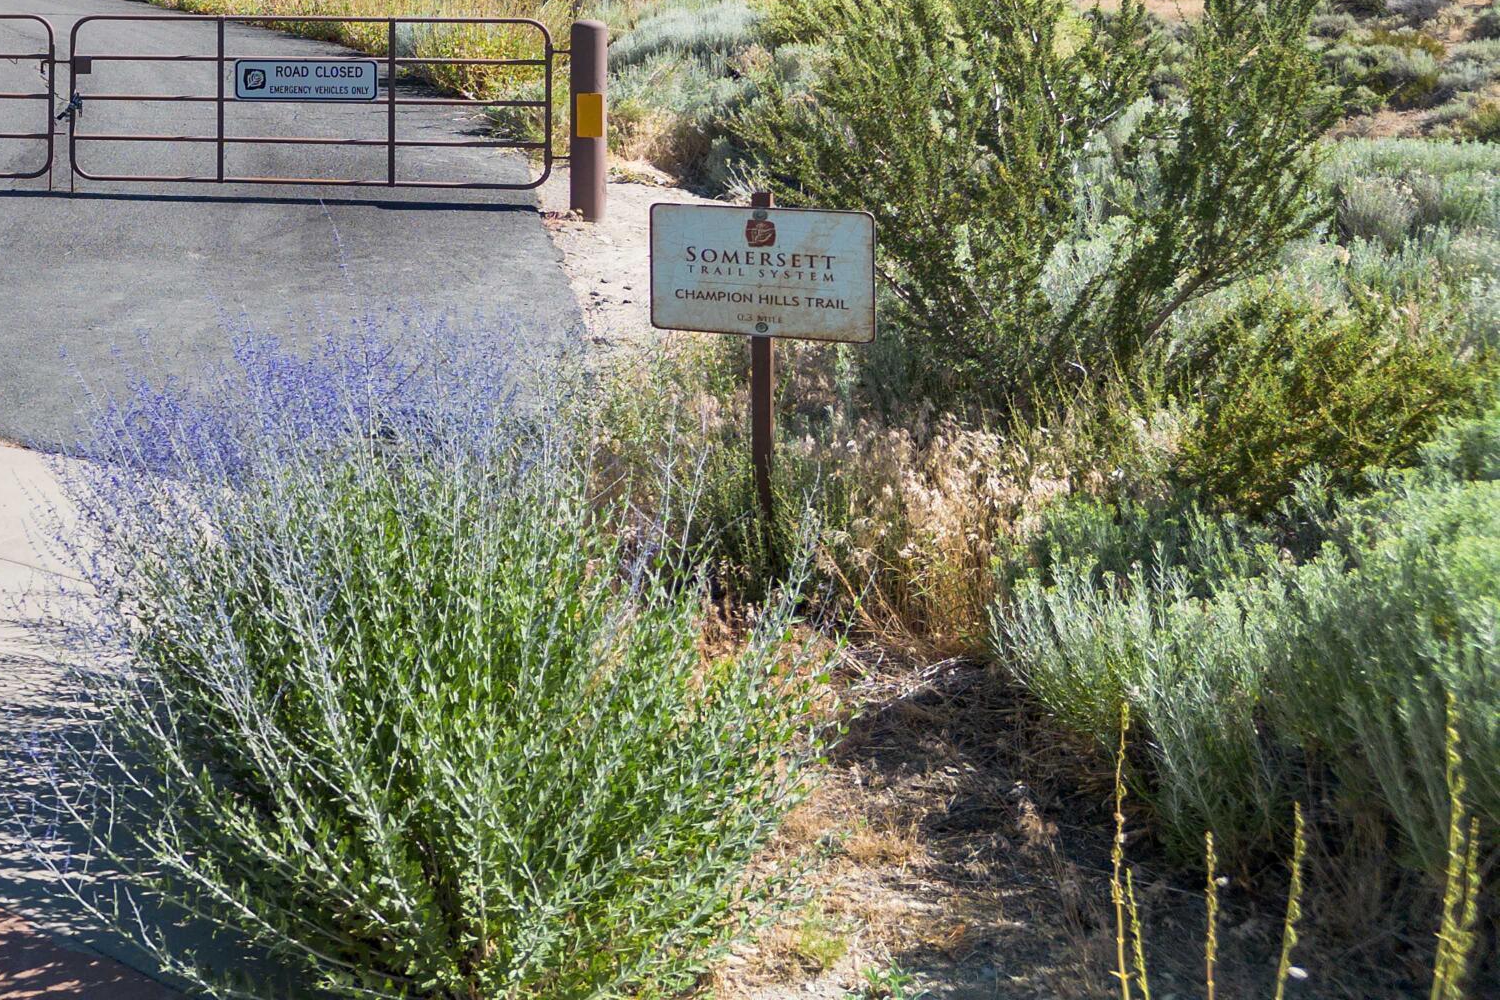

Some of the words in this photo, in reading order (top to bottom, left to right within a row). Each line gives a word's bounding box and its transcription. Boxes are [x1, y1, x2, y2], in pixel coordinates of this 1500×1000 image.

[275, 65, 309, 78] ROAD
[315, 66, 364, 78] CLOSED
[269, 85, 312, 94] EMERGENCY
[314, 86, 349, 95] VEHICLES
[351, 86, 370, 95] ONLY
[685, 246, 837, 270] SOMERSETT
[687, 264, 745, 277] TRAIL
[758, 269, 835, 282] SYSTEM
[674, 288, 753, 304] CHAMPION
[758, 294, 800, 307] HILLS
[807, 297, 850, 310] TRAIL
